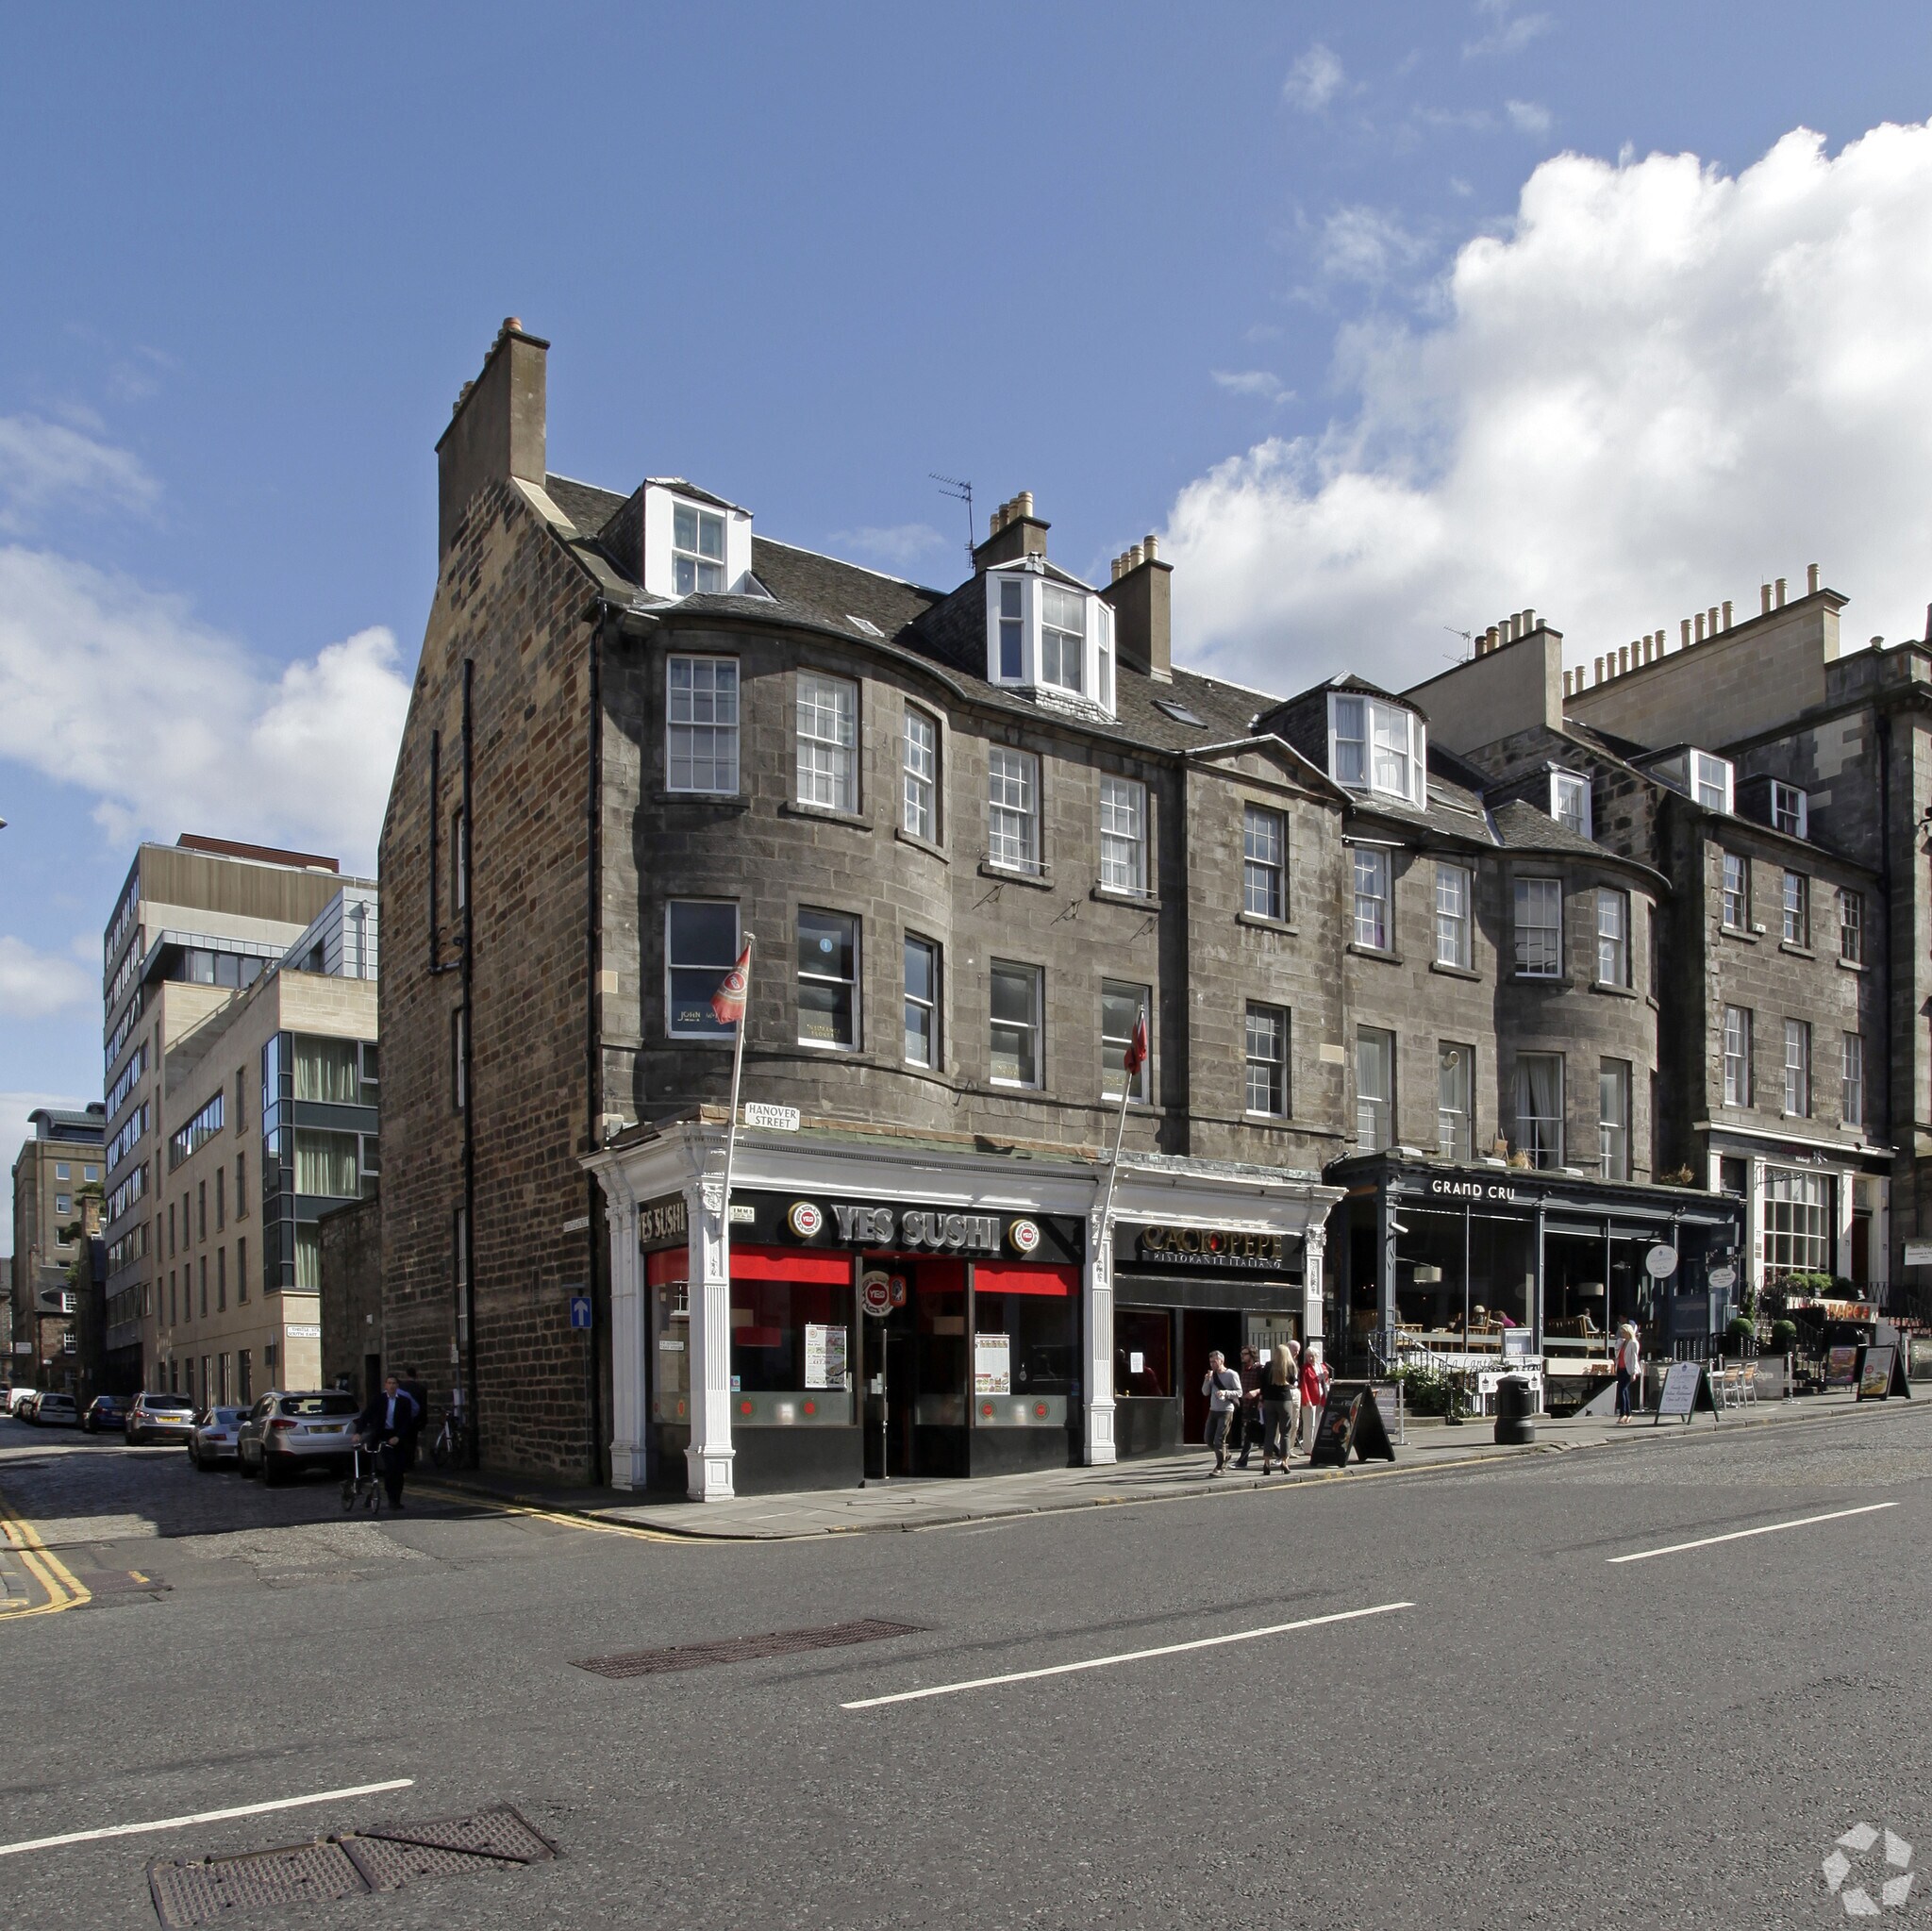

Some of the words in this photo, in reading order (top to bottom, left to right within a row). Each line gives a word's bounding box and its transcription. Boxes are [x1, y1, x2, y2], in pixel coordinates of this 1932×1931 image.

[677, 1011, 701, 1022] JOHN
[749, 1105, 796, 1119] HANOVER
[755, 1116, 791, 1128] STREET
[1432, 1179, 1482, 1197] GRAND
[1488, 1186, 1515, 1200] CRU
[654, 1203, 686, 1238] SUSHI
[831, 1204, 894, 1244] YES
[902, 1210, 1000, 1252] SUSHI
[1229, 1257, 1281, 1269] ITALIANO
[869, 1290, 886, 1299] YES
